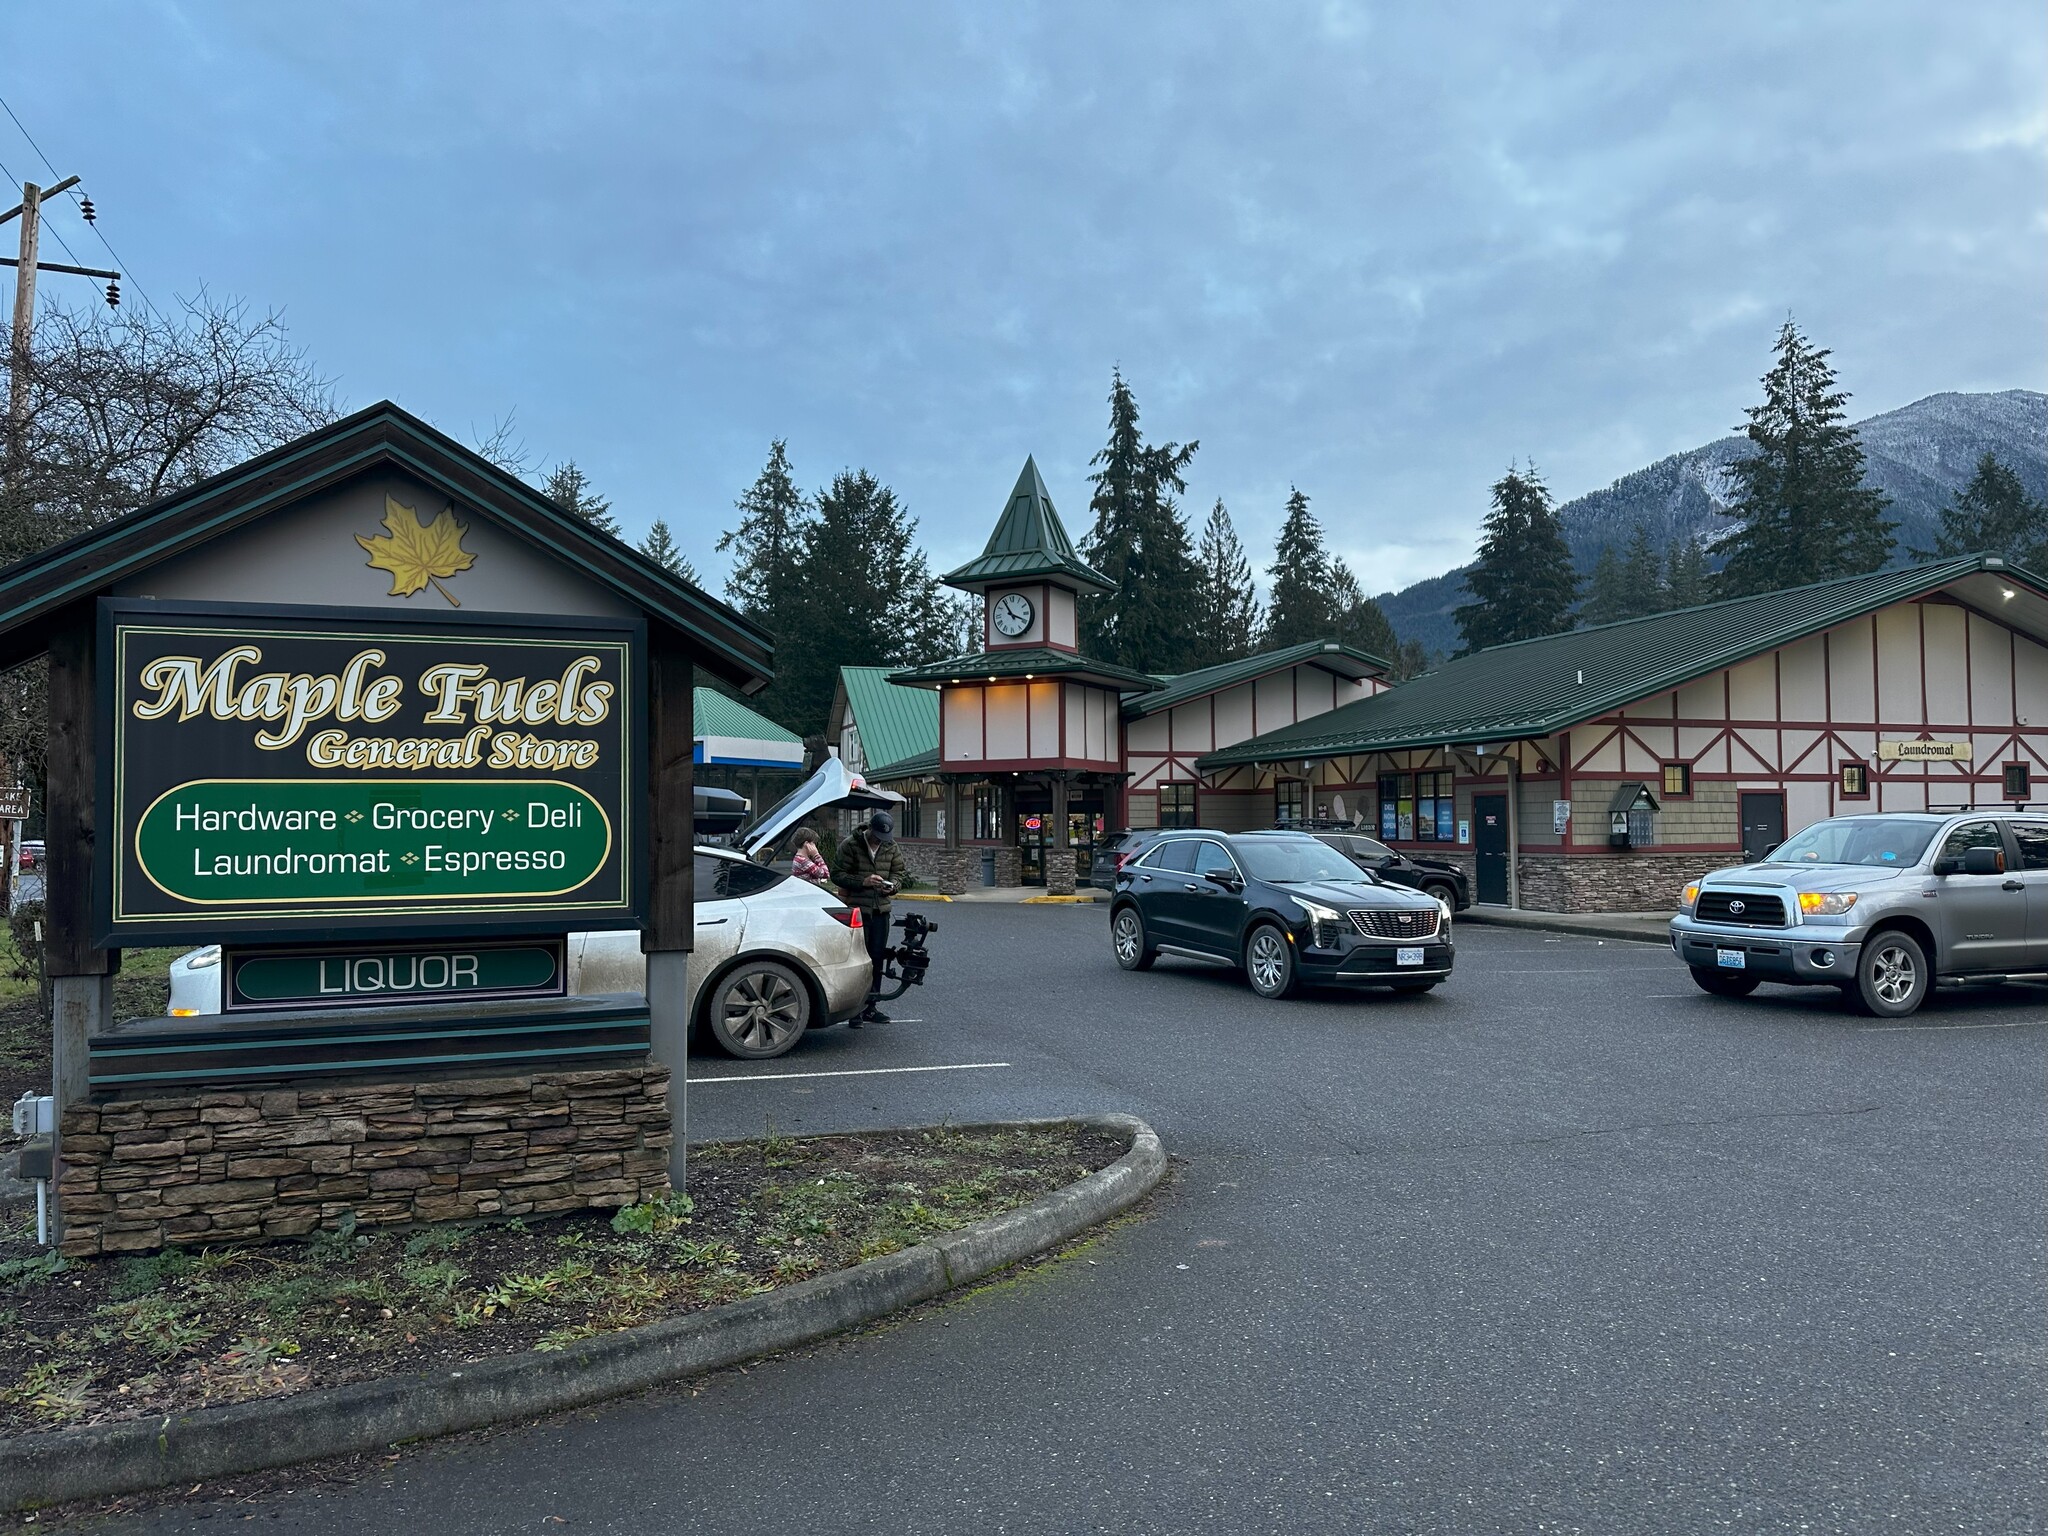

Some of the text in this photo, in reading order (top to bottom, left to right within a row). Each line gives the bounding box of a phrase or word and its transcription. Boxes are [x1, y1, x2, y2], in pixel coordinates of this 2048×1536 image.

[133, 645, 615, 751] Maple Fuels
[306, 725, 600, 771] General Store
[1897, 743, 1955, 757] Laundromat
[0, 791, 23, 801] AKE
[0, 804, 24, 814] AREA
[174, 802, 583, 835] Hardware Grocery Deli
[193, 844, 567, 877] Laundromat Espresso
[319, 954, 479, 993] LIQUOR
